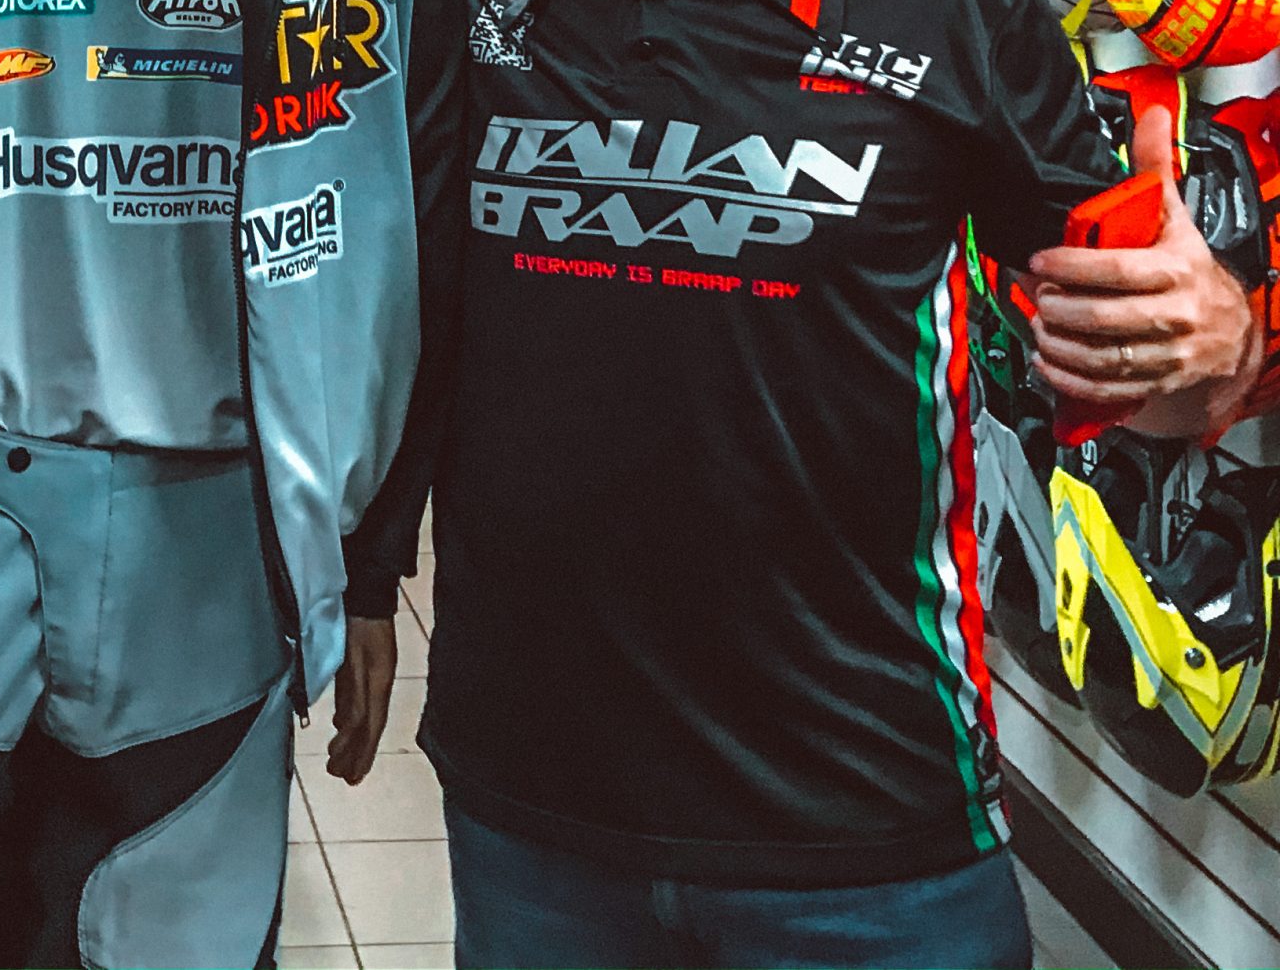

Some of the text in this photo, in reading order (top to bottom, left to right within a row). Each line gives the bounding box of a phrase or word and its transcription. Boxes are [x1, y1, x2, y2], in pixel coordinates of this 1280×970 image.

[132, 58, 234, 76] MICHELIN
[475, 115, 883, 204] ITALIAN
[113, 201, 195, 218] FACTORY
[469, 180, 814, 258] BRAAP
[514, 252, 801, 300] EVERYDAY IS BRAAP DAY
